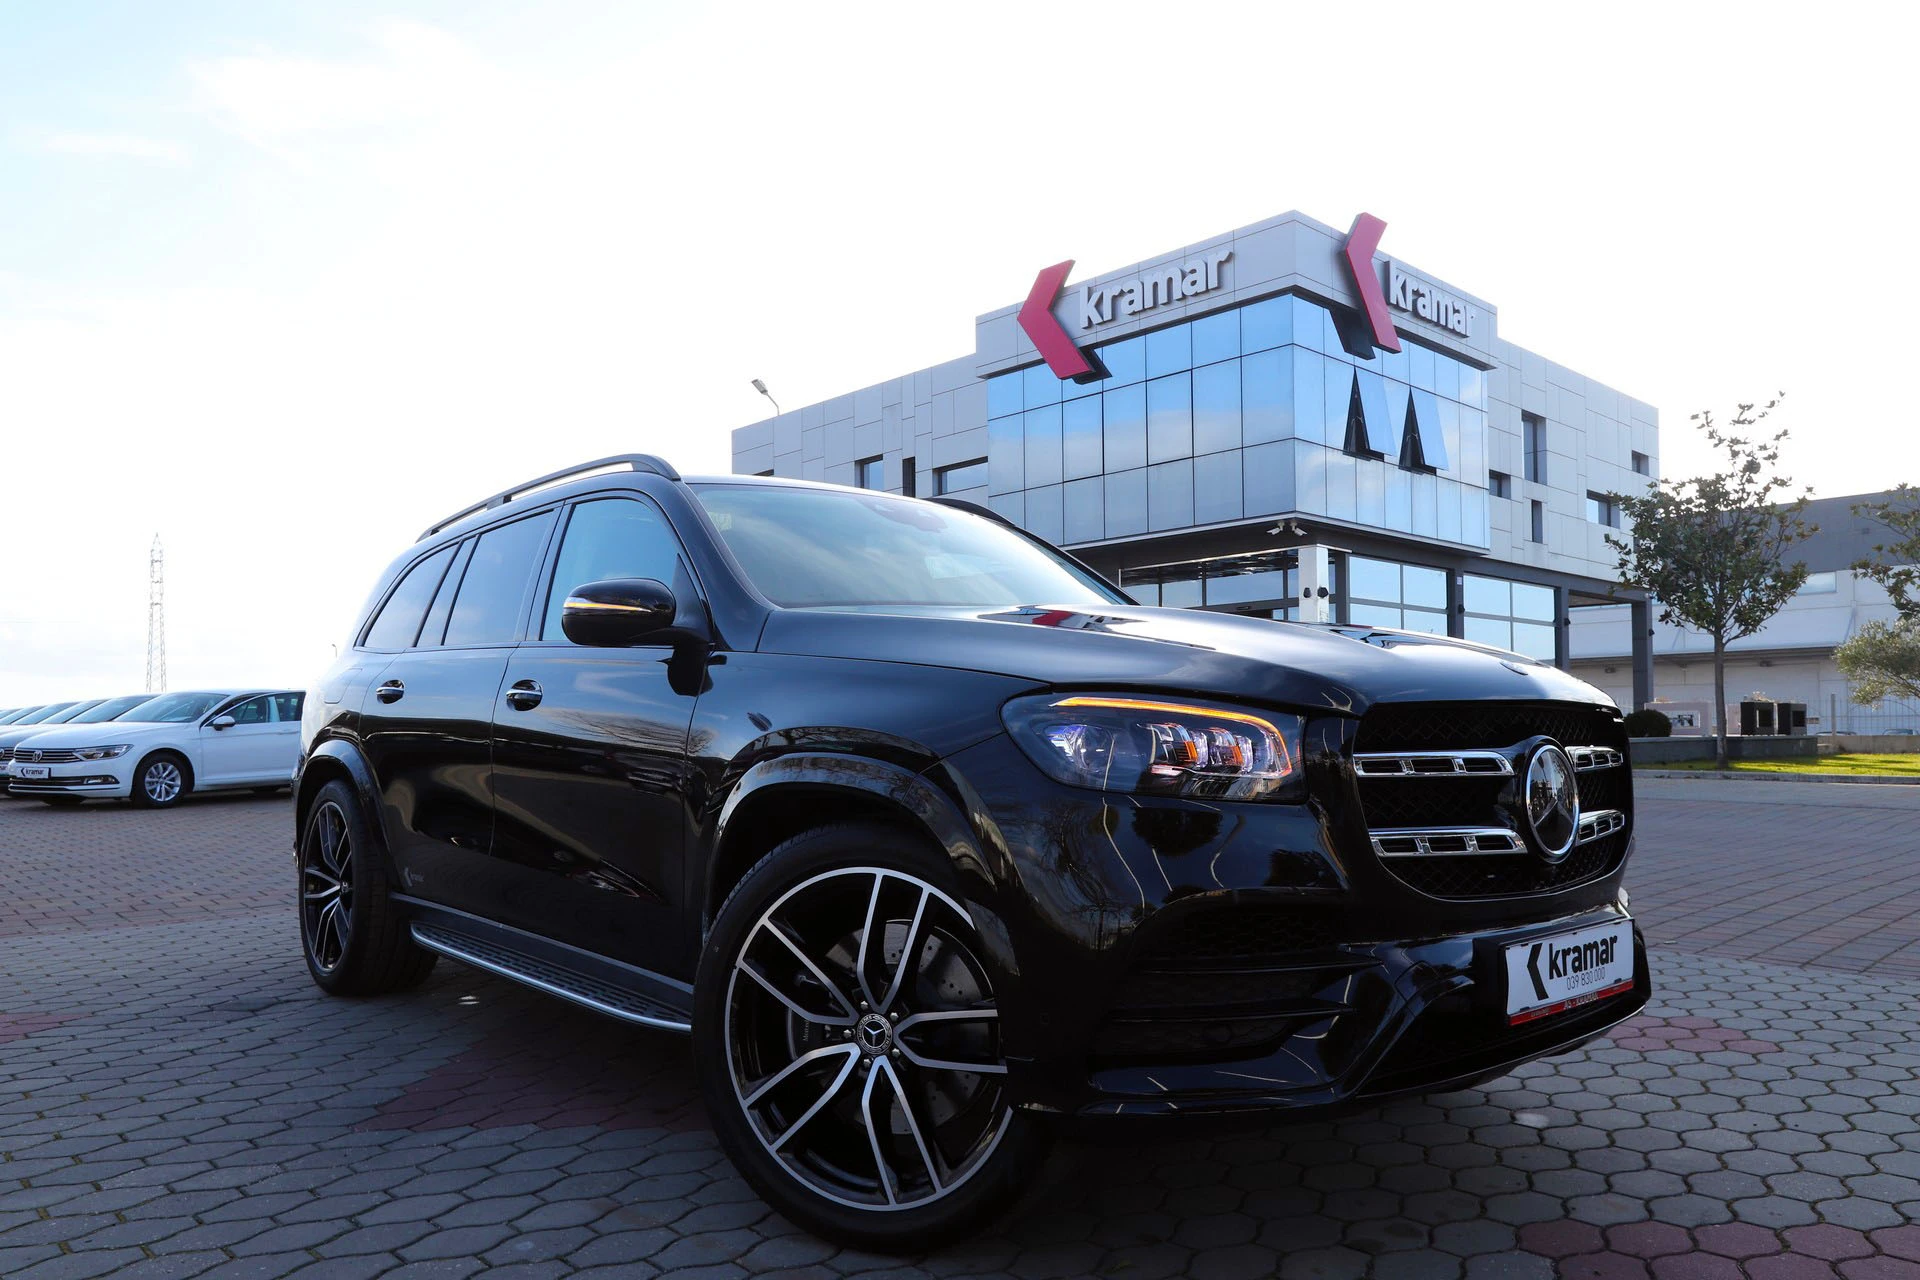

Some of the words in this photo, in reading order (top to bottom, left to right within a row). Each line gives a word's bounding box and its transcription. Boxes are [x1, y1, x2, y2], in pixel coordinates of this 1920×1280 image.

[1080, 250, 1233, 329] kramar
[1387, 260, 1476, 338] kramar
[1549, 935, 1618, 980] kramar
[1566, 974, 1580, 990] 039
[1581, 970, 1593, 986] 830
[1593, 966, 1606, 982] 000
